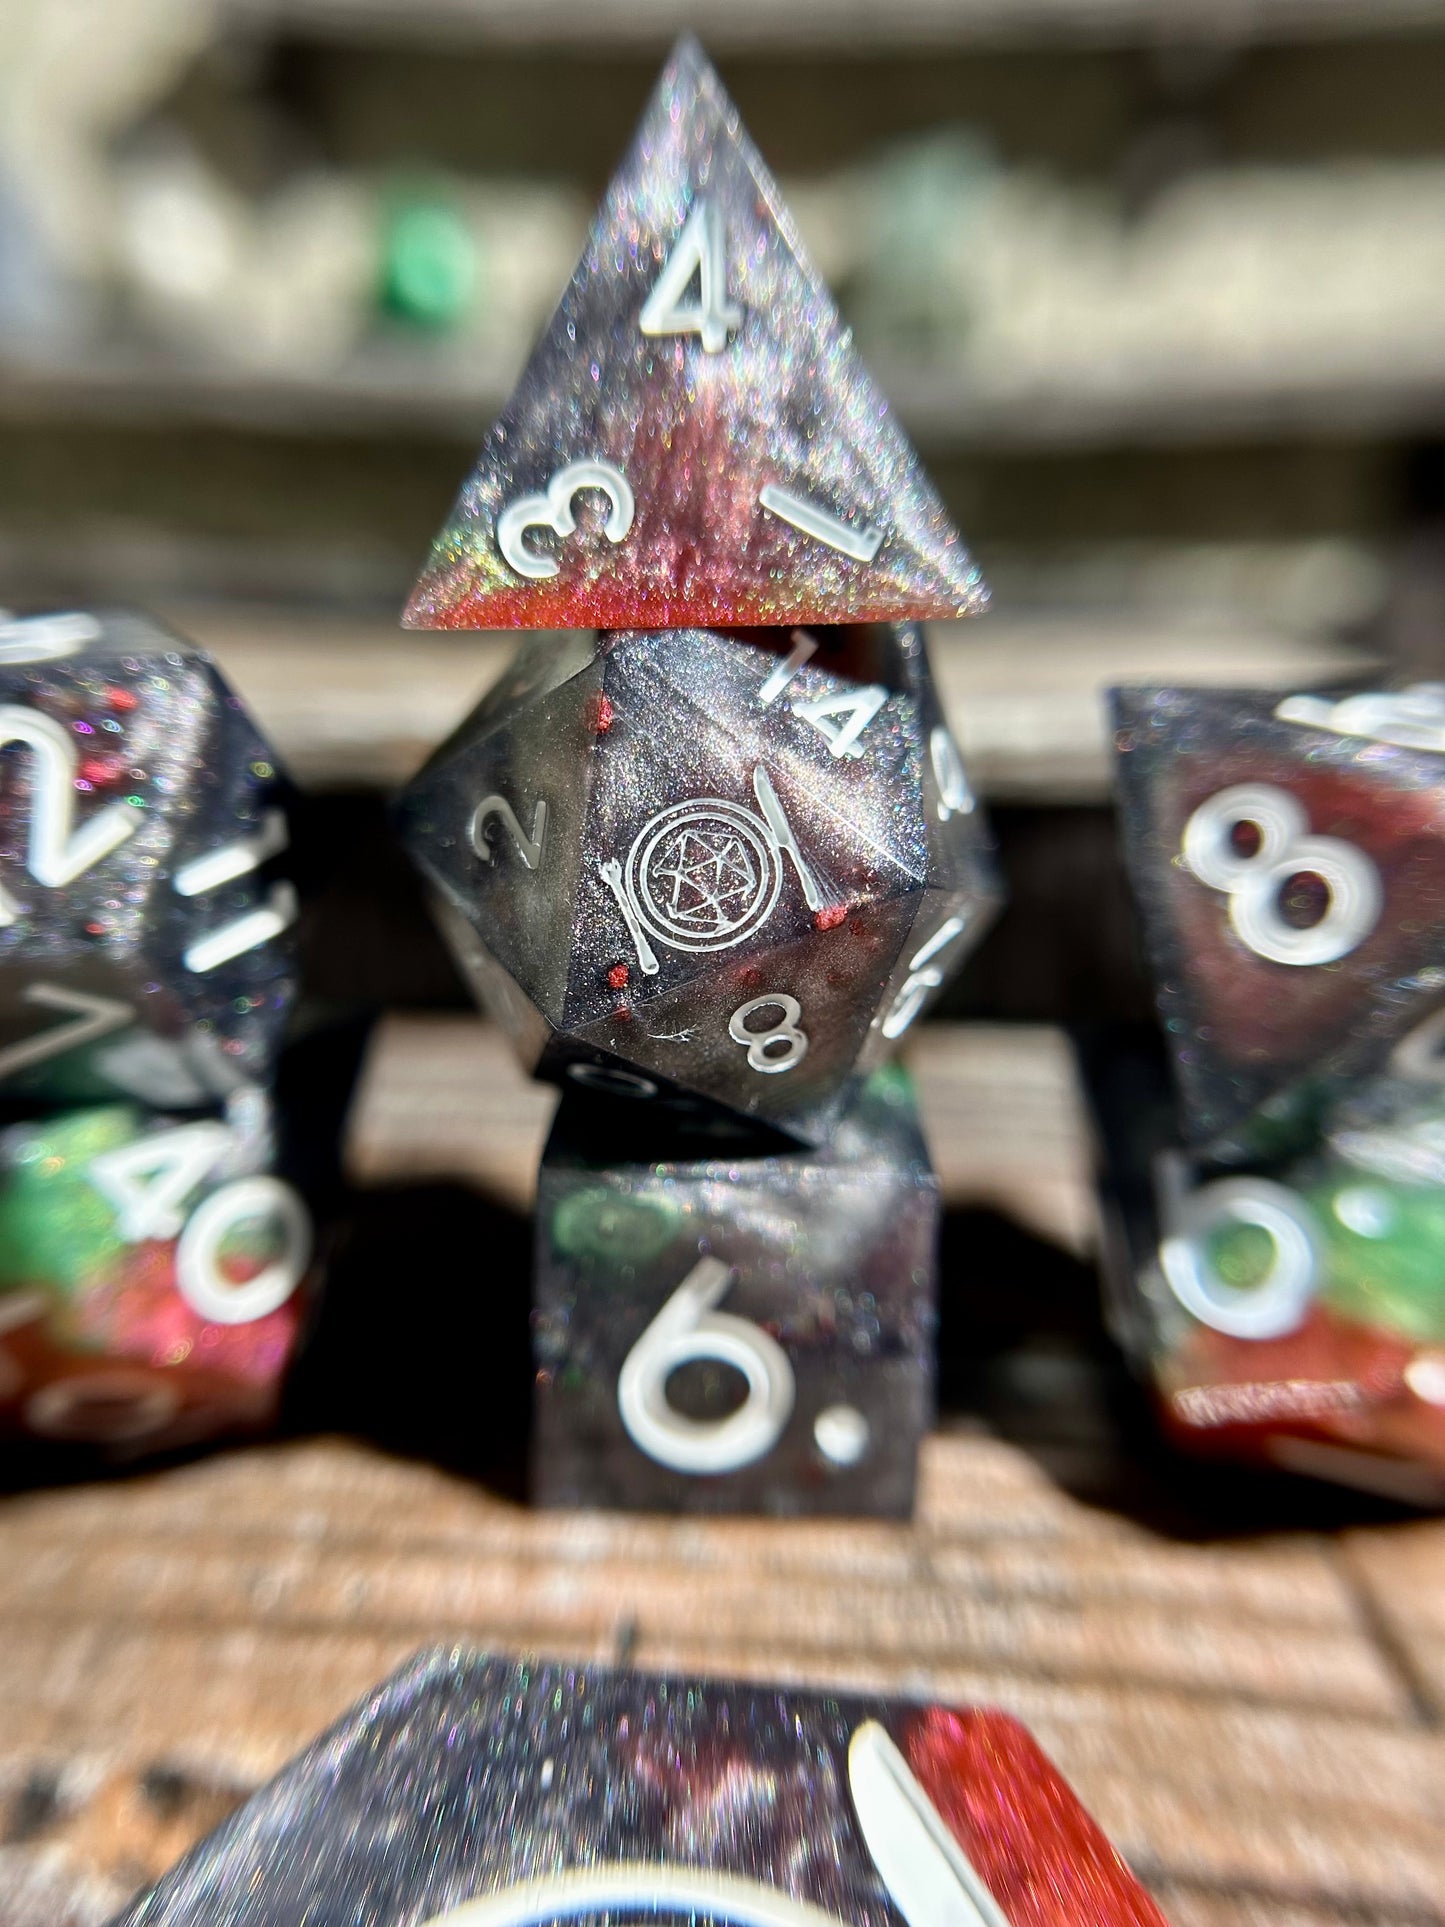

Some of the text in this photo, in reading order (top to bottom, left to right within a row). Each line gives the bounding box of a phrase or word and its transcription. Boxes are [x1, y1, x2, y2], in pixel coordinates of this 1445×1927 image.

[639, 199, 742, 353] 4
[497, 460, 635, 579] 3
[758, 484, 885, 563] 1
[758, 630, 891, 759] 14
[470, 795, 547, 870] 2
[1181, 782, 1384, 966] 8
[729, 993, 809, 1074] 8
[87, 1120, 315, 1326] 40
